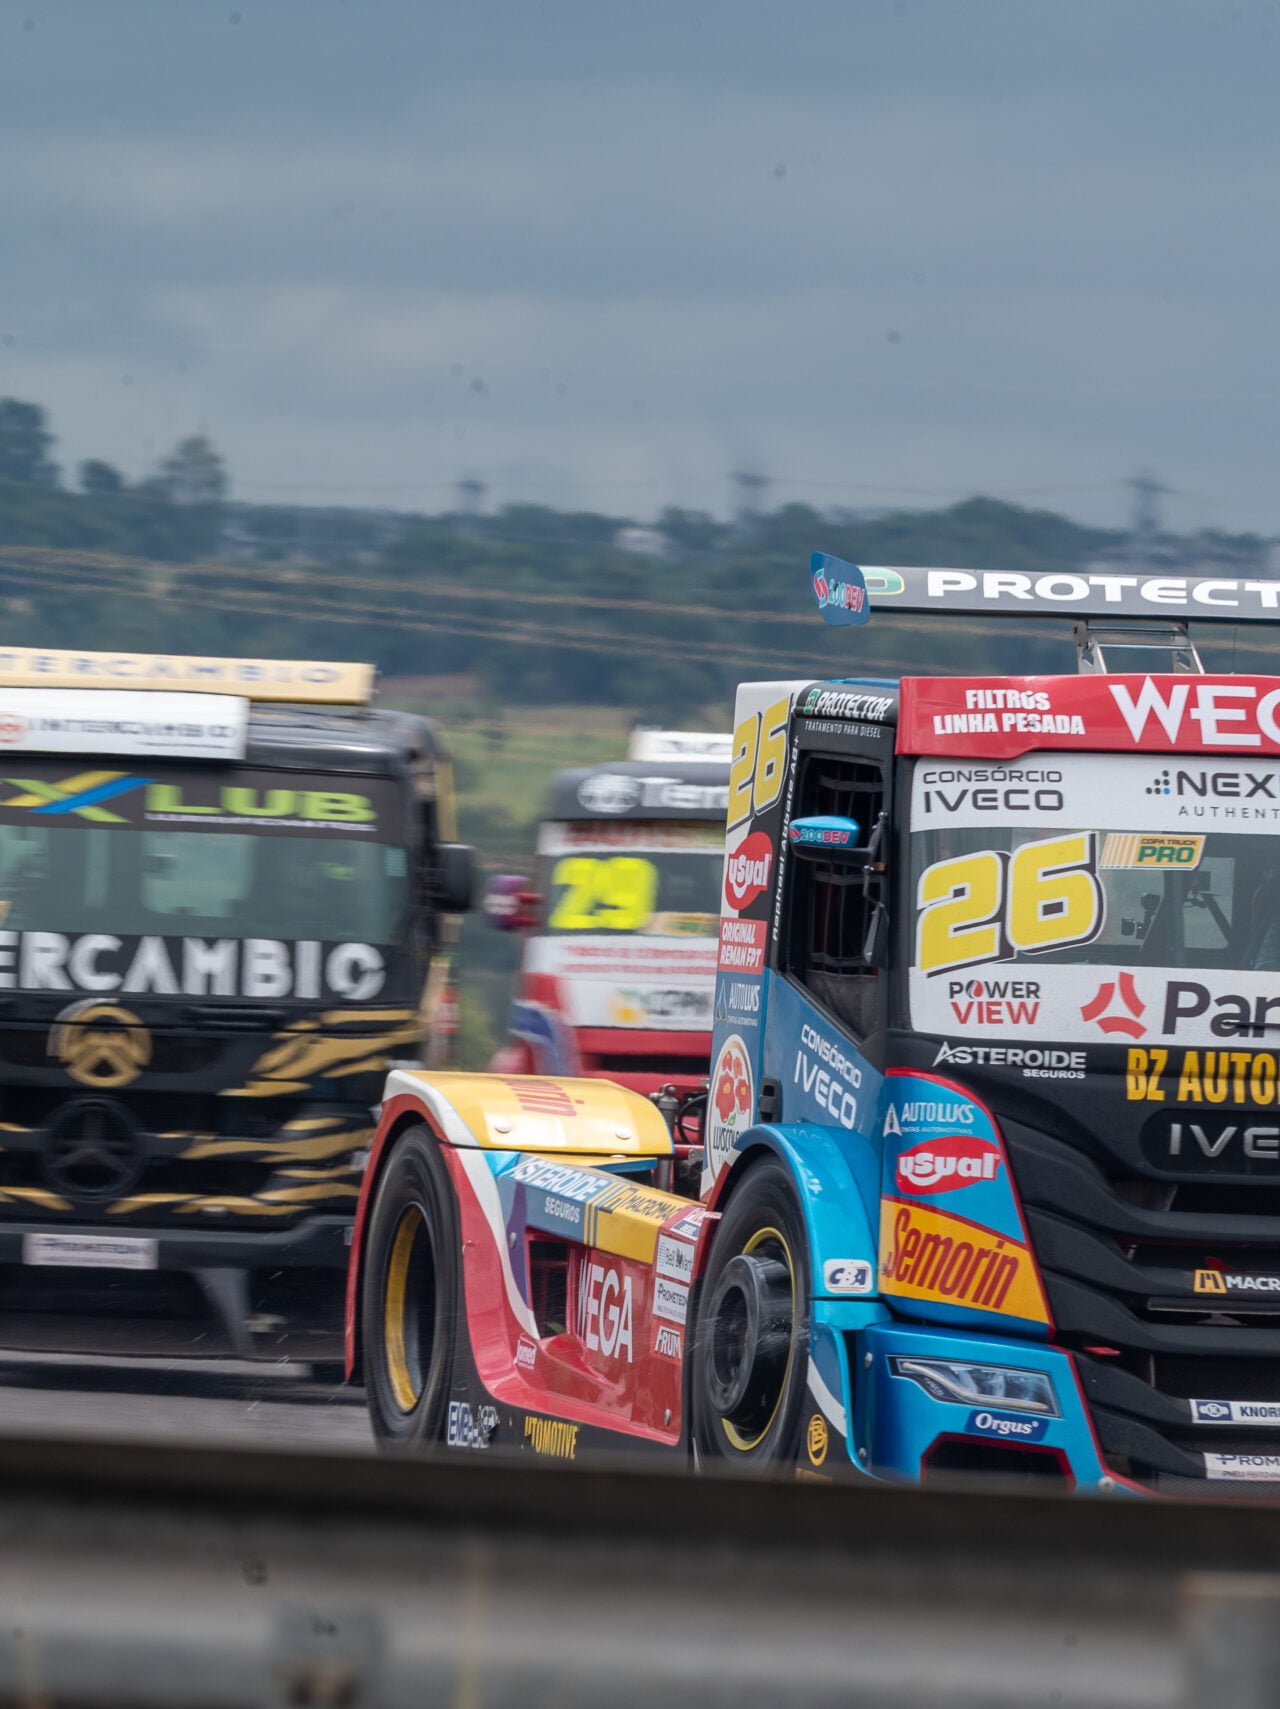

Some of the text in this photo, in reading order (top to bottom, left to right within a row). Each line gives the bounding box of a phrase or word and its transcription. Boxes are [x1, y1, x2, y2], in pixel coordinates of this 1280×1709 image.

[814, 691, 894, 721] PROTECTOR
[965, 689, 1051, 711] FILTROS
[805, 720, 881, 738] TRATAMENTO PARA DIESEL
[933, 713, 1086, 735] LINHA PESADA
[727, 694, 791, 830] 26
[923, 766, 1062, 784] CONSÓRCIO
[923, 789, 1064, 813] IVECO
[801, 829, 850, 843] 200DEV
[1137, 845, 1195, 863] PRO
[548, 857, 658, 929] 29
[916, 832, 1105, 977] 26
[722, 922, 756, 944] ORIGINAL
[720, 945, 747, 966] REMAN
[746, 947, 762, 967] FPT
[949, 979, 1040, 999] POWER
[950, 1001, 1041, 1025] VIEW
[801, 1024, 862, 1089] CONSÓRCIO
[932, 1041, 1087, 1068] ASTEROIDE
[1022, 1068, 1086, 1079] SEGUROS
[1125, 1048, 1168, 1101] BZ
[794, 1051, 856, 1129] IVECO
[901, 1102, 975, 1124] AUTOLUKS
[501, 1157, 609, 1200] ASTEROIDE
[899, 1152, 995, 1184] usual
[544, 1197, 581, 1223] SEGUROS
[884, 1207, 1019, 1310] Semorin
[975, 1412, 1033, 1434] Orgus
